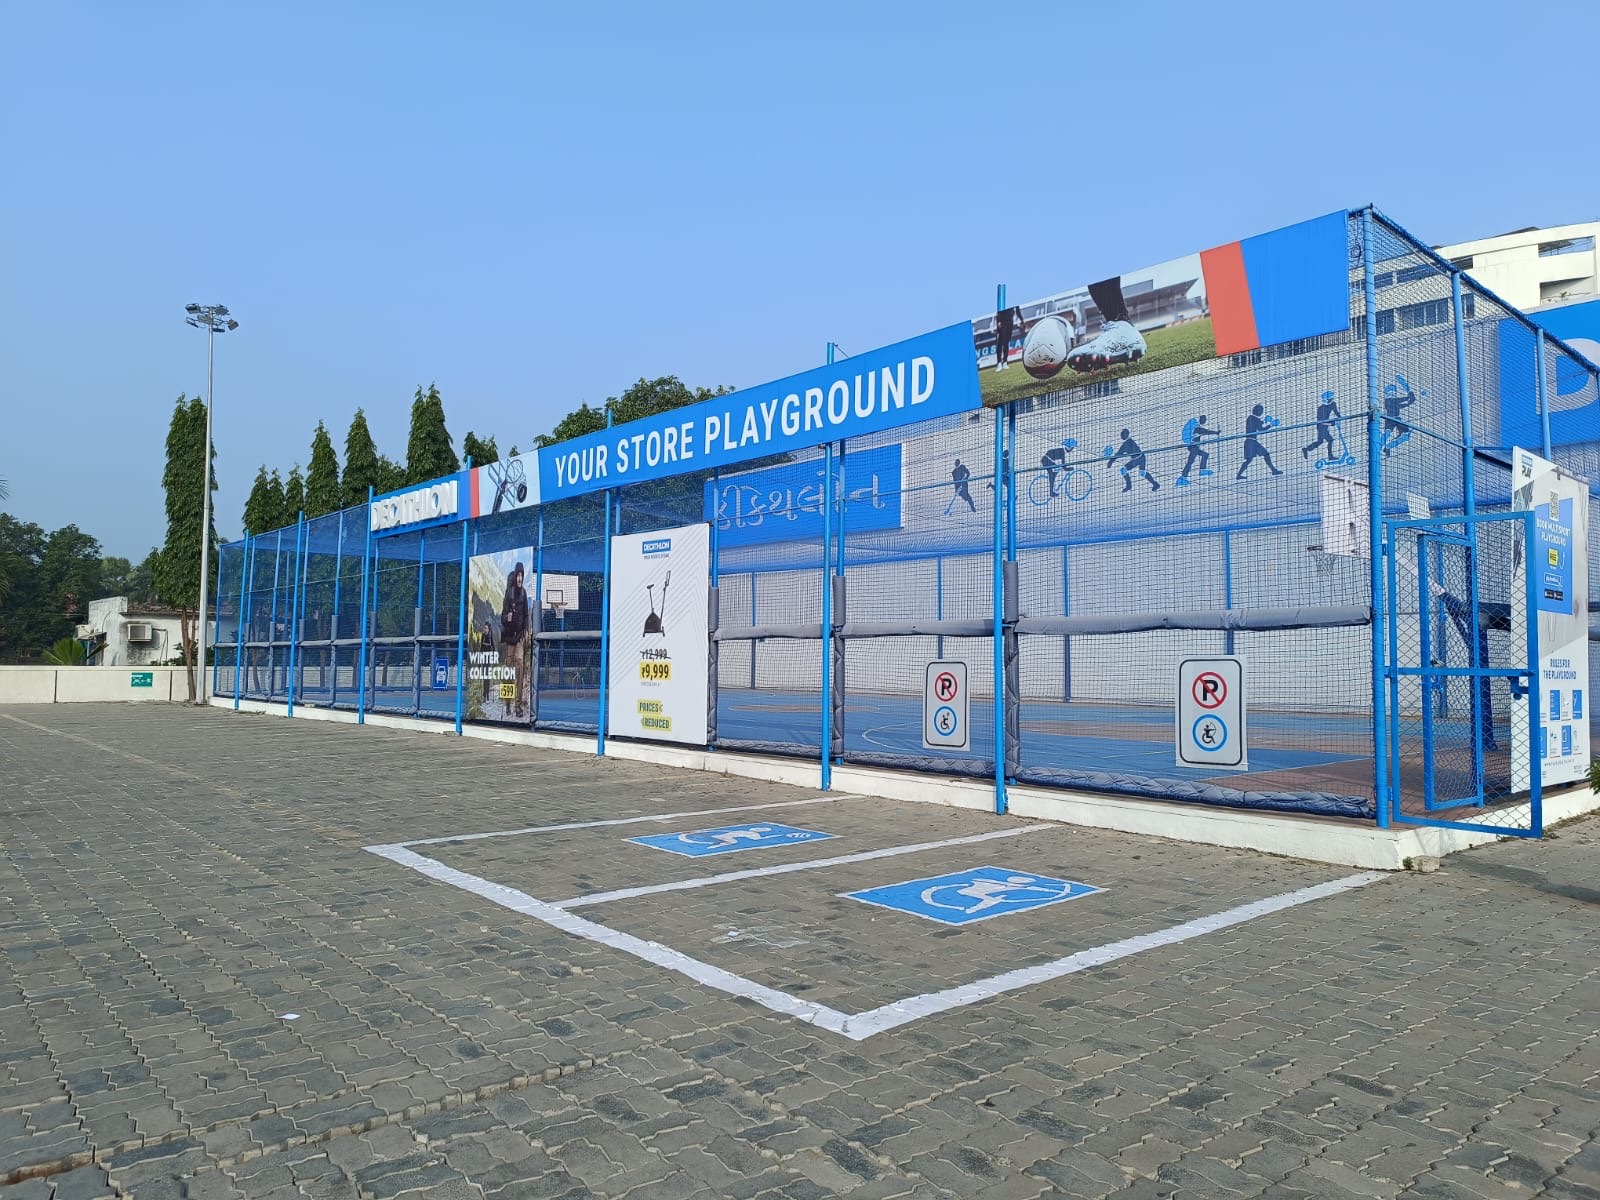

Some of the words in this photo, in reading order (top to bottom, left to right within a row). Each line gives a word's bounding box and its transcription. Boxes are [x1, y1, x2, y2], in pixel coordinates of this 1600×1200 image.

[555, 445, 608, 488] YOUR
[616, 422, 694, 474] STORE
[704, 356, 935, 455] PLAYGROUND
[371, 480, 458, 532] DECATHLON
[469, 651, 499, 664] WINTER
[469, 667, 516, 680] COLLECTION
[641, 664, 669, 681] ₹9,999
[1202, 680, 1219, 702] P
[639, 702, 659, 713] PRICES
[644, 718, 670, 729] REDUCED
